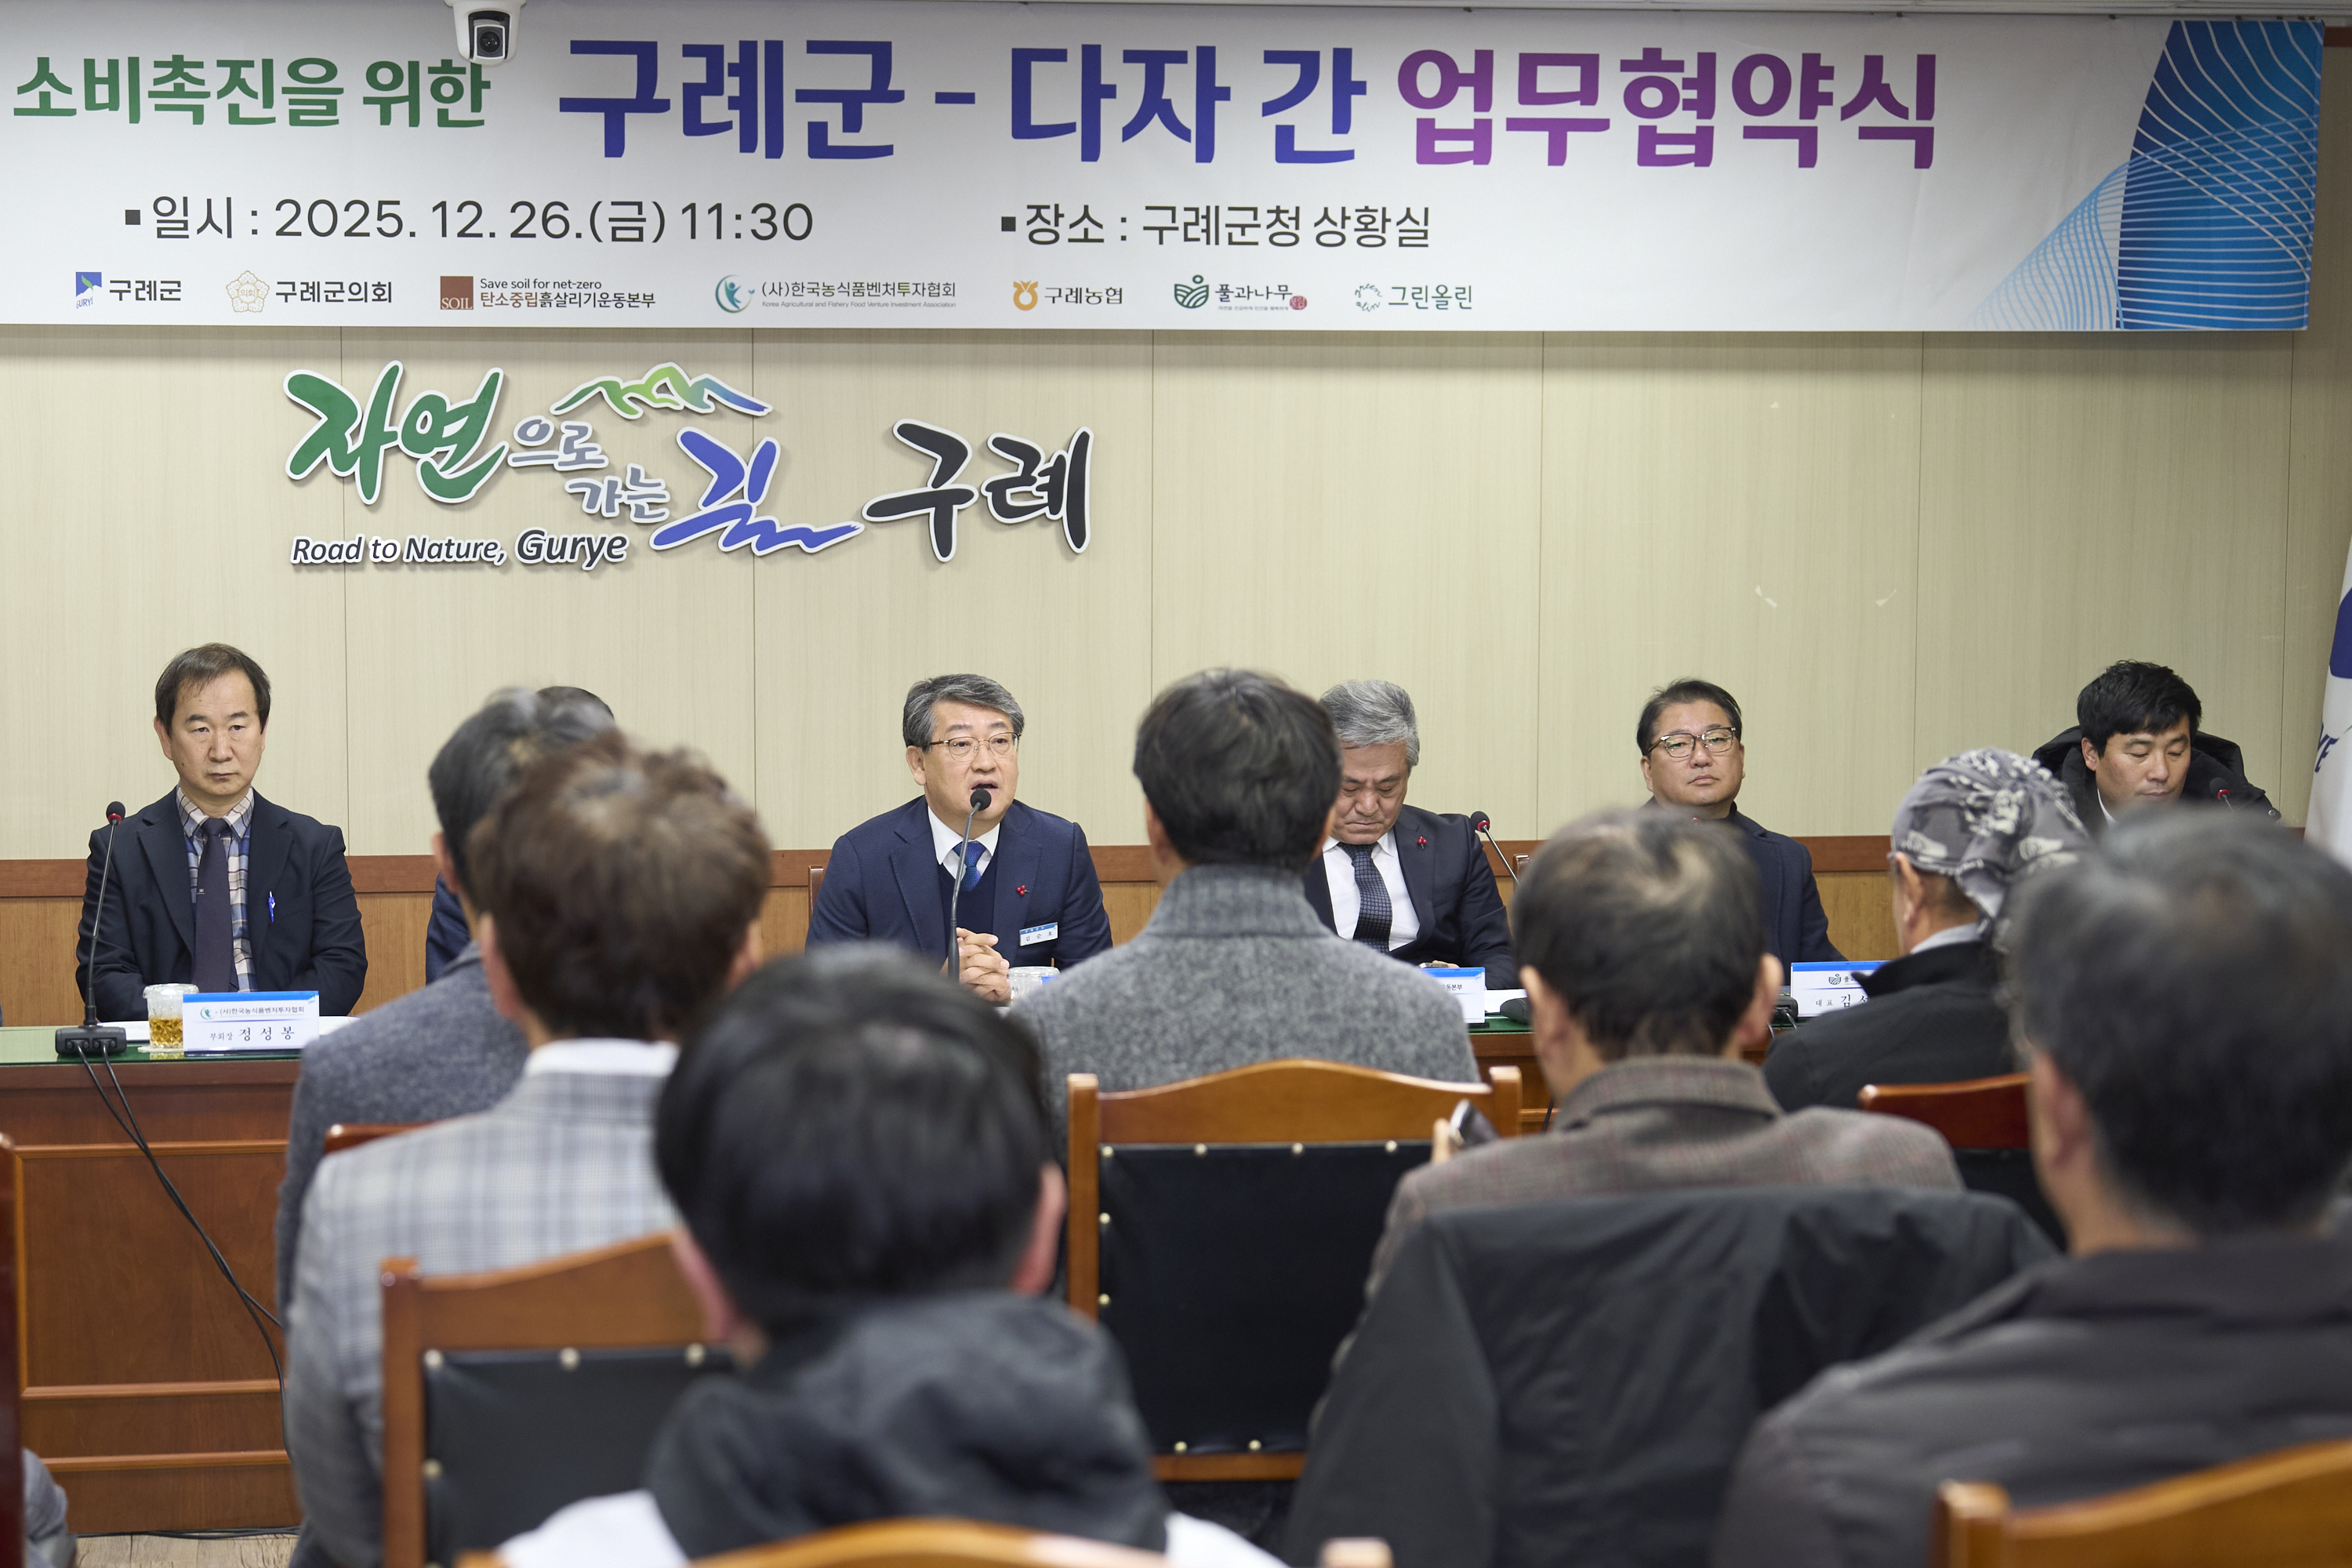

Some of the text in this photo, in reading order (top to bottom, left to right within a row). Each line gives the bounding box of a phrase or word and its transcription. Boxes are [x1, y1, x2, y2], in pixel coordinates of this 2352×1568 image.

[14, 54, 344, 126] 소비촉진을
[363, 59, 491, 128] 위한
[560, 40, 905, 159] 구례군
[1011, 44, 1231, 163] 다자
[1261, 47, 1367, 164] 간
[1398, 47, 1936, 169] 업무협약식
[153, 196, 232, 239] 일시
[275, 199, 416, 238] 2025.
[432, 200, 495, 238] 12.
[510, 201, 666, 243] 26.(금)
[681, 202, 813, 241] 11:30
[1025, 204, 1105, 245] 장소
[1142, 205, 1301, 247] 구례군청
[1313, 205, 1430, 248] 상황실
[109, 280, 181, 301] 구례군
[275, 281, 392, 303] 구례군의회
[480, 278, 602, 289] Save soil for net-zero
[761, 281, 956, 298] (사)한국농식품벤처투자협회
[1215, 283, 1292, 303] 풀과나무
[441, 298, 473, 310] SOIL
[480, 292, 655, 308] 탄소중립흙살리기운동본부
[1044, 287, 1123, 305] 구례농협
[1388, 285, 1473, 310] 그린올린
[566, 466, 671, 522] 가는
[650, 427, 865, 556] 길
[864, 419, 1094, 560] 구례
[292, 529, 627, 568] Road to Nature, Gurye
